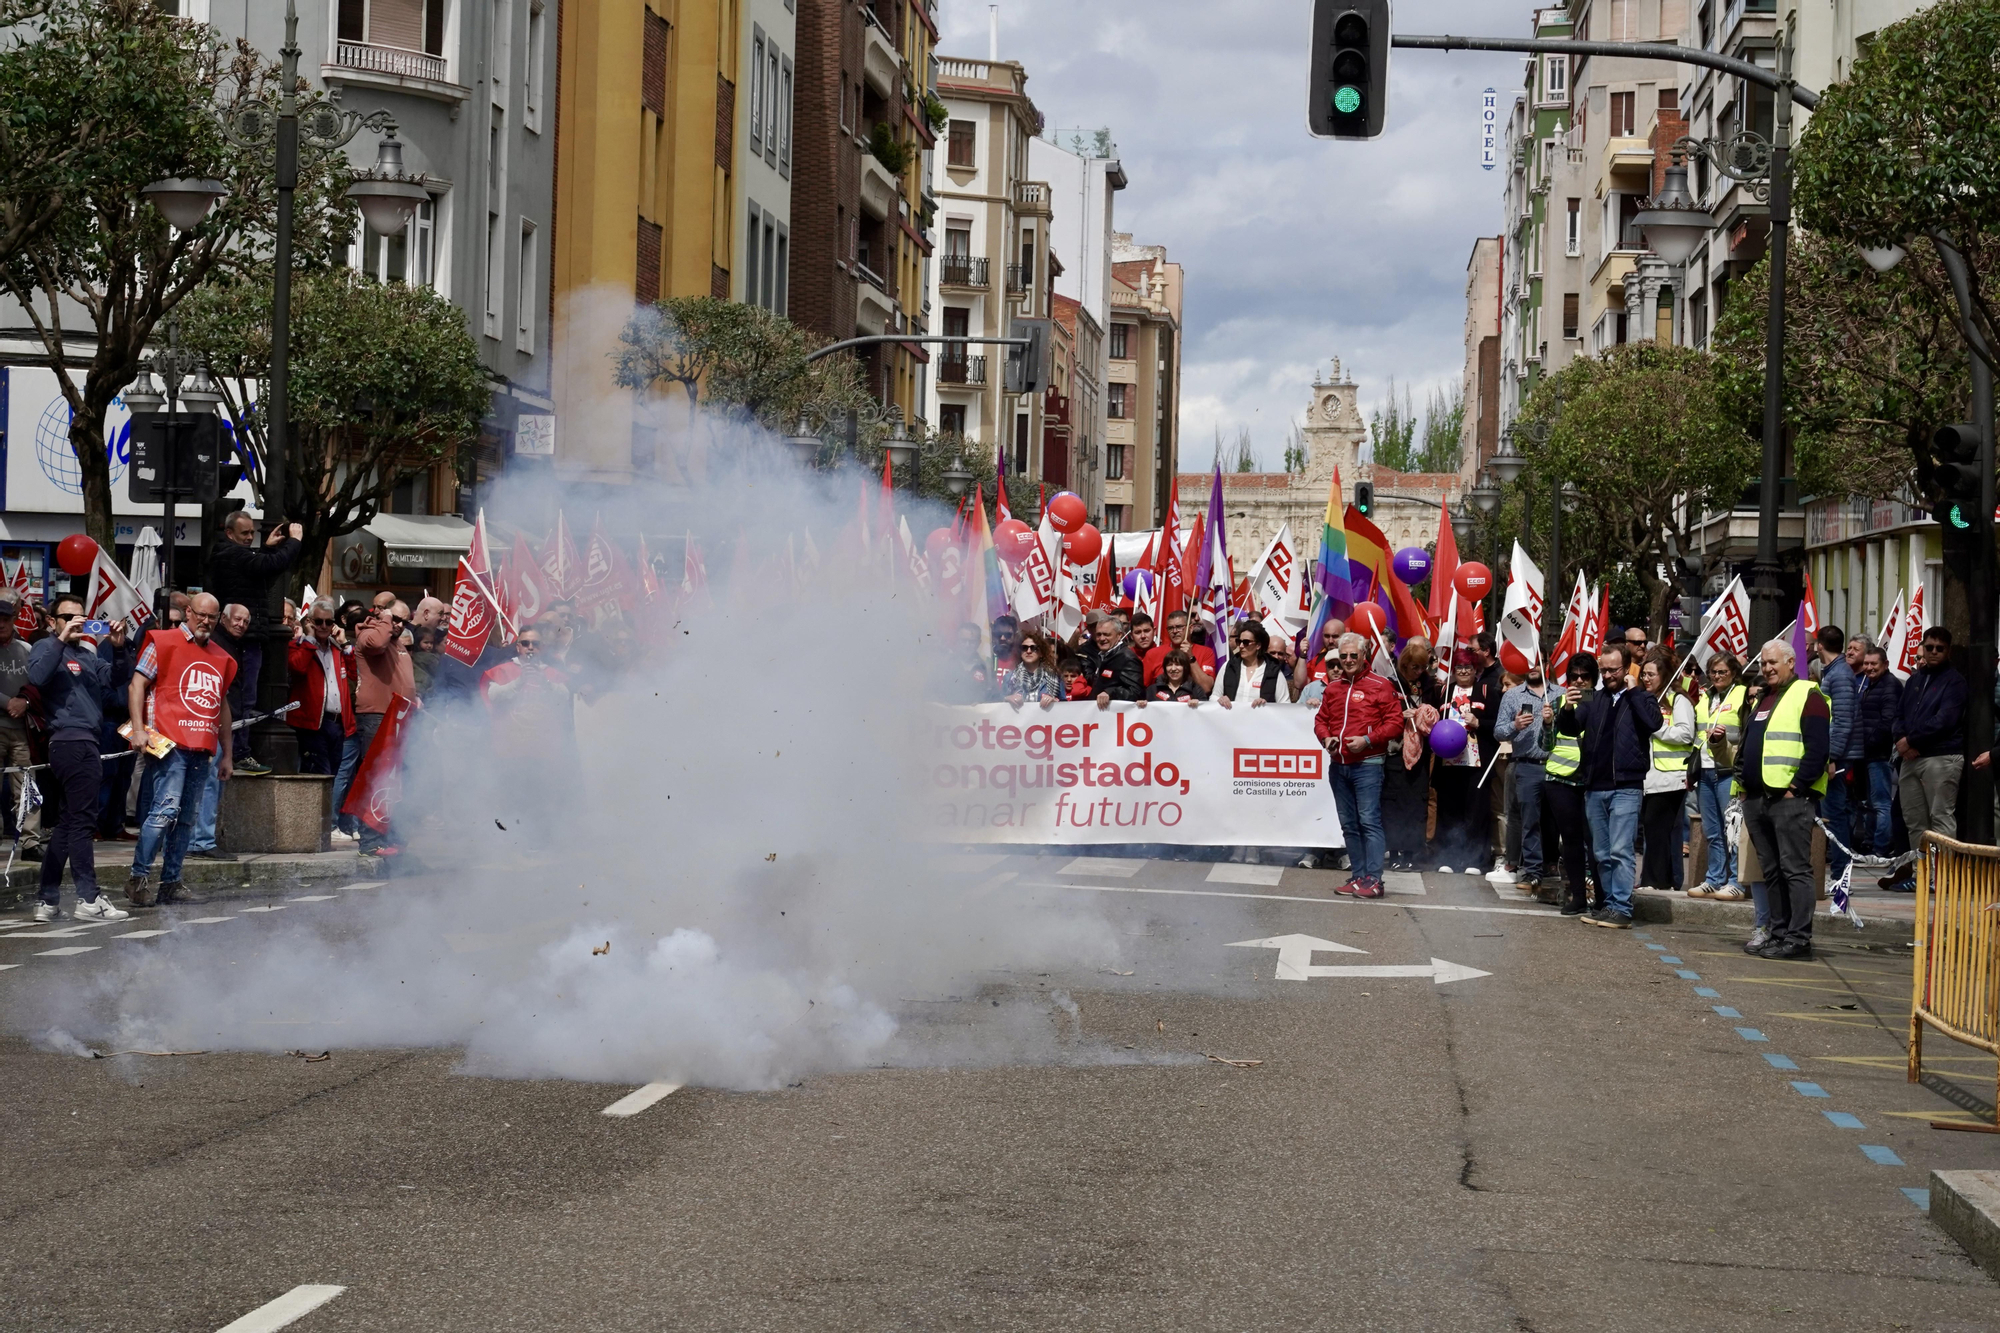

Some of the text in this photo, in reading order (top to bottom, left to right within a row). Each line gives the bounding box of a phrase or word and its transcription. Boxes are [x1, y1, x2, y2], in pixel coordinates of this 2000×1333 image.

[1483, 96, 1495, 161] HOTEL
[1266, 578, 1282, 602] León
[449, 583, 479, 629] UGT
[188, 669, 221, 695] UGT
[178, 719, 205, 727] mano
[908, 712, 1154, 760] roteger lo
[928, 751, 1190, 798] onquistado,
[1237, 752, 1318, 776] CCOO
[1245, 787, 1276, 795] Castilla
[930, 792, 1183, 828] anar futuro
